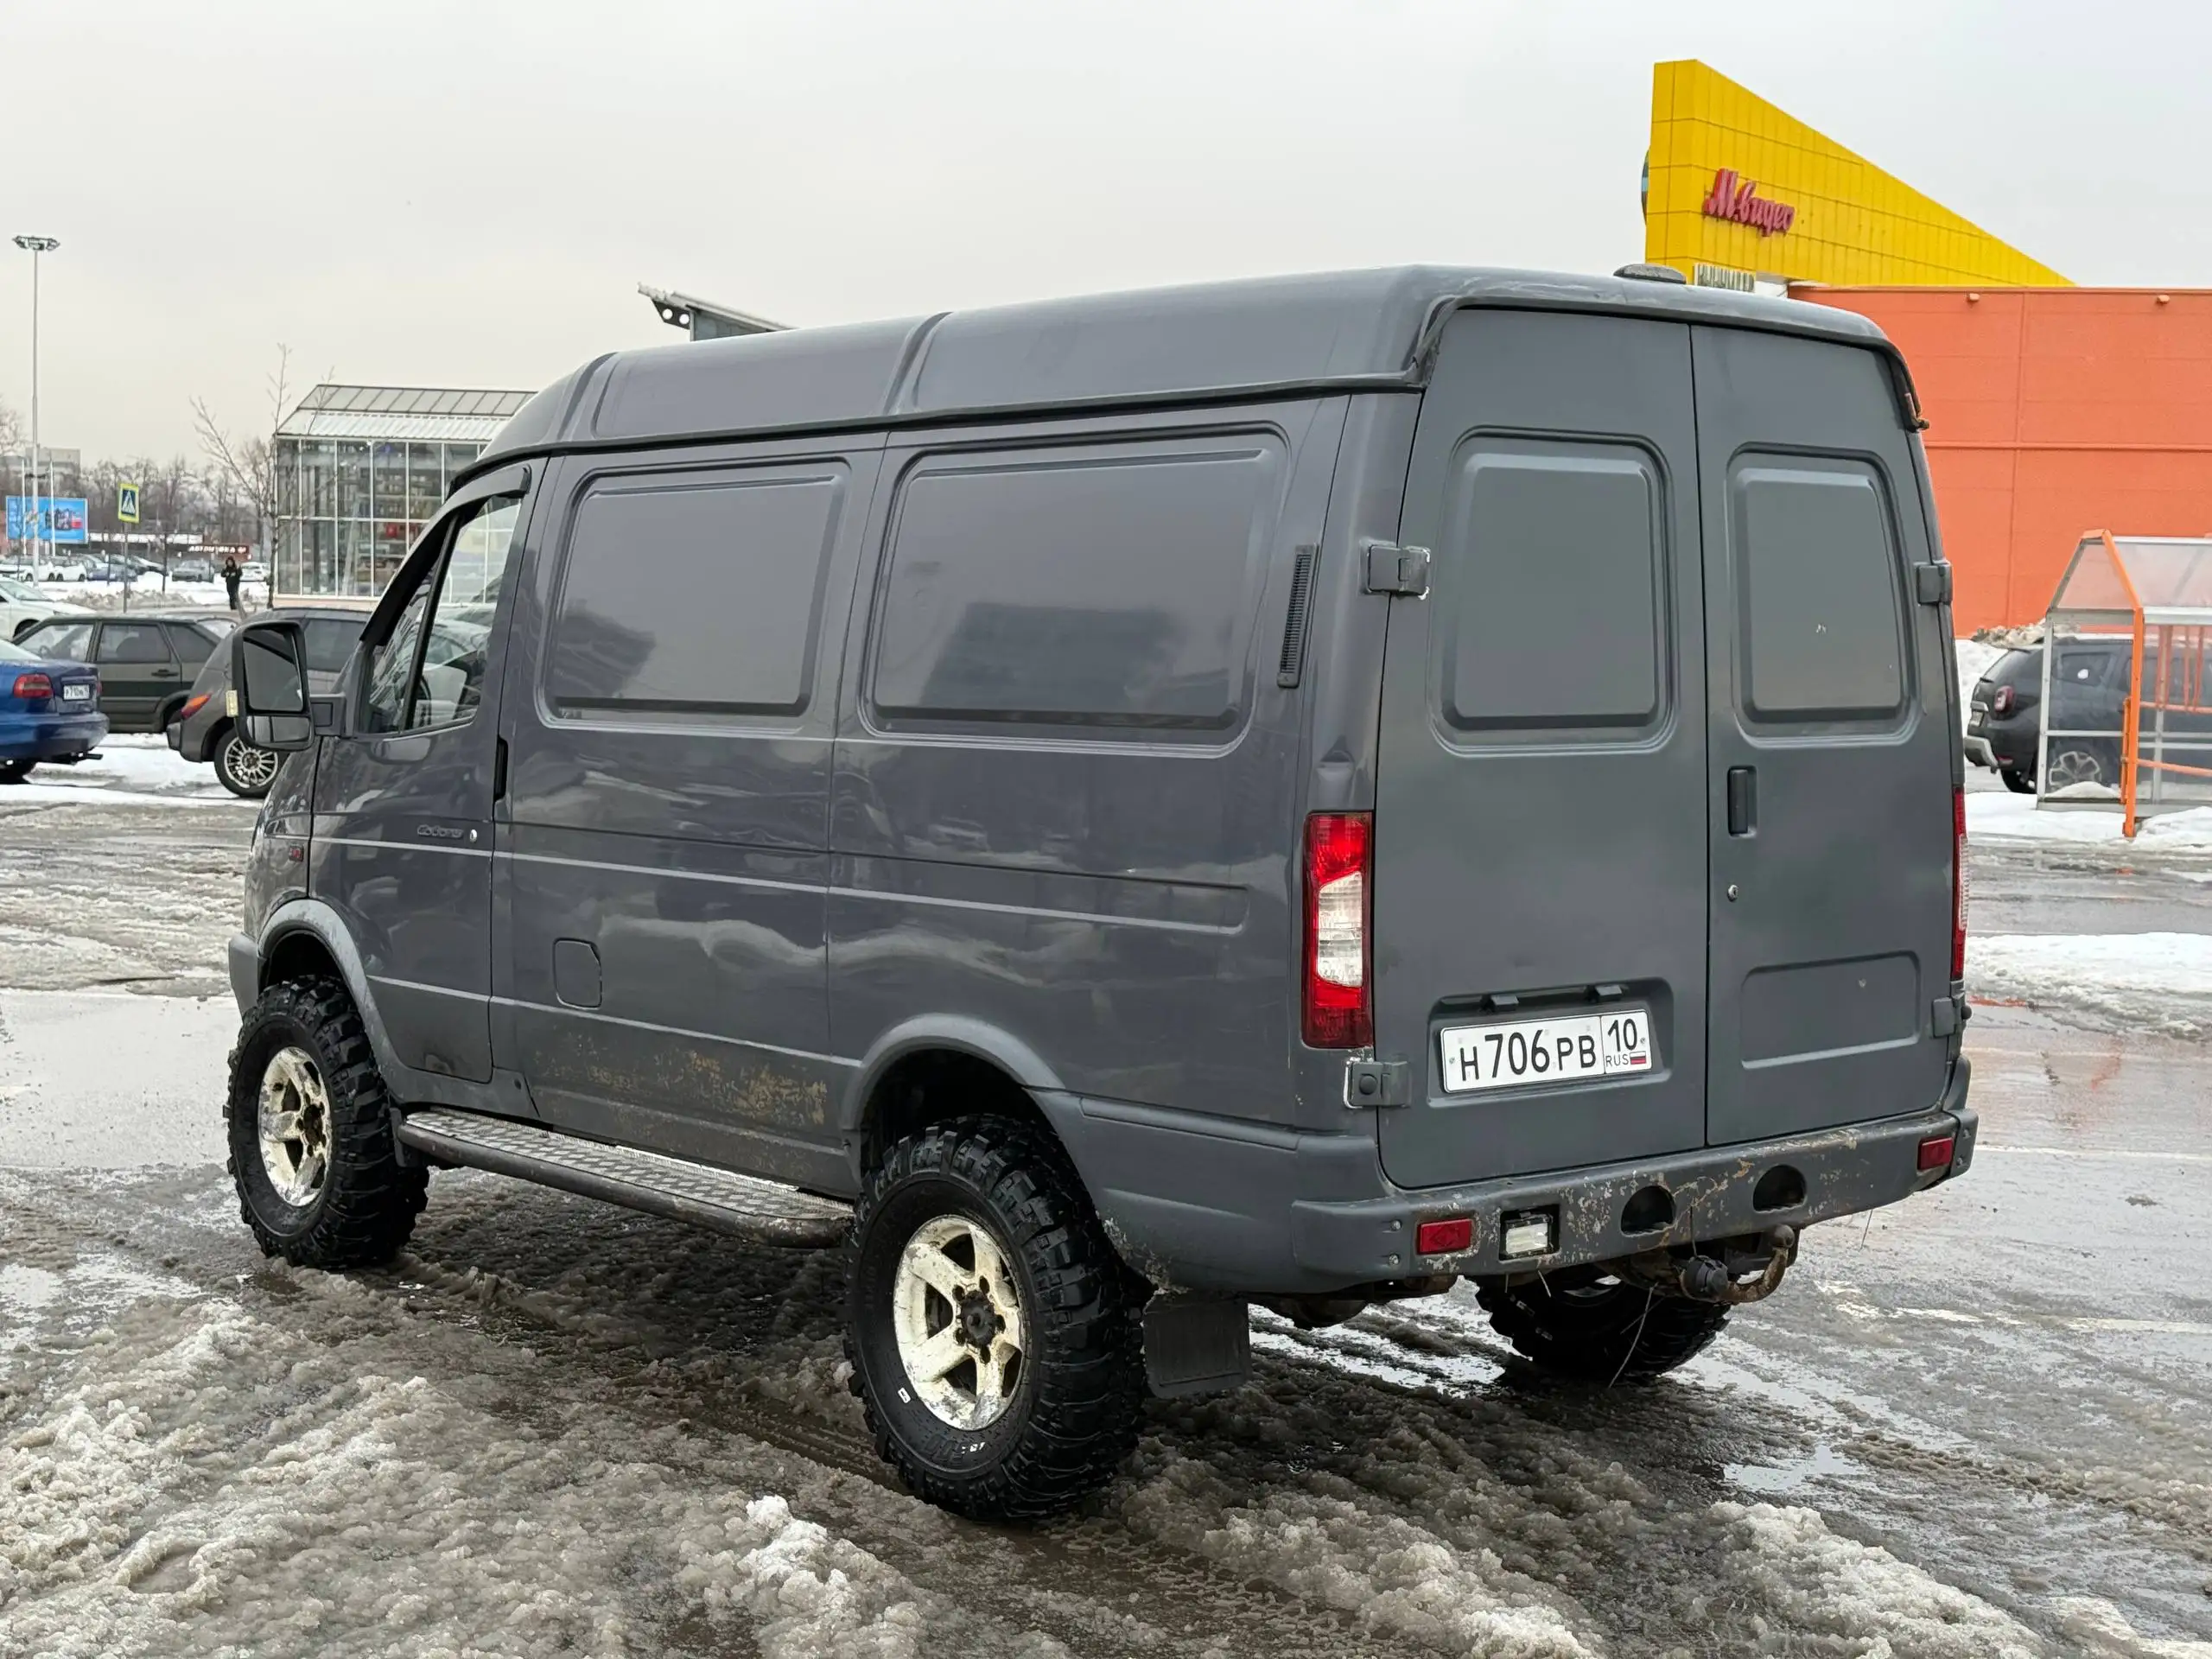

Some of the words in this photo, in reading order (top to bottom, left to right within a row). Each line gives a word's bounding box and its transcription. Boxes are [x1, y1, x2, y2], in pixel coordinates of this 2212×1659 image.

[1459, 1029, 1597, 1082] Н706РВ
[1607, 1018, 1638, 1052] 10
[1605, 1053, 1630, 1067] RUS
